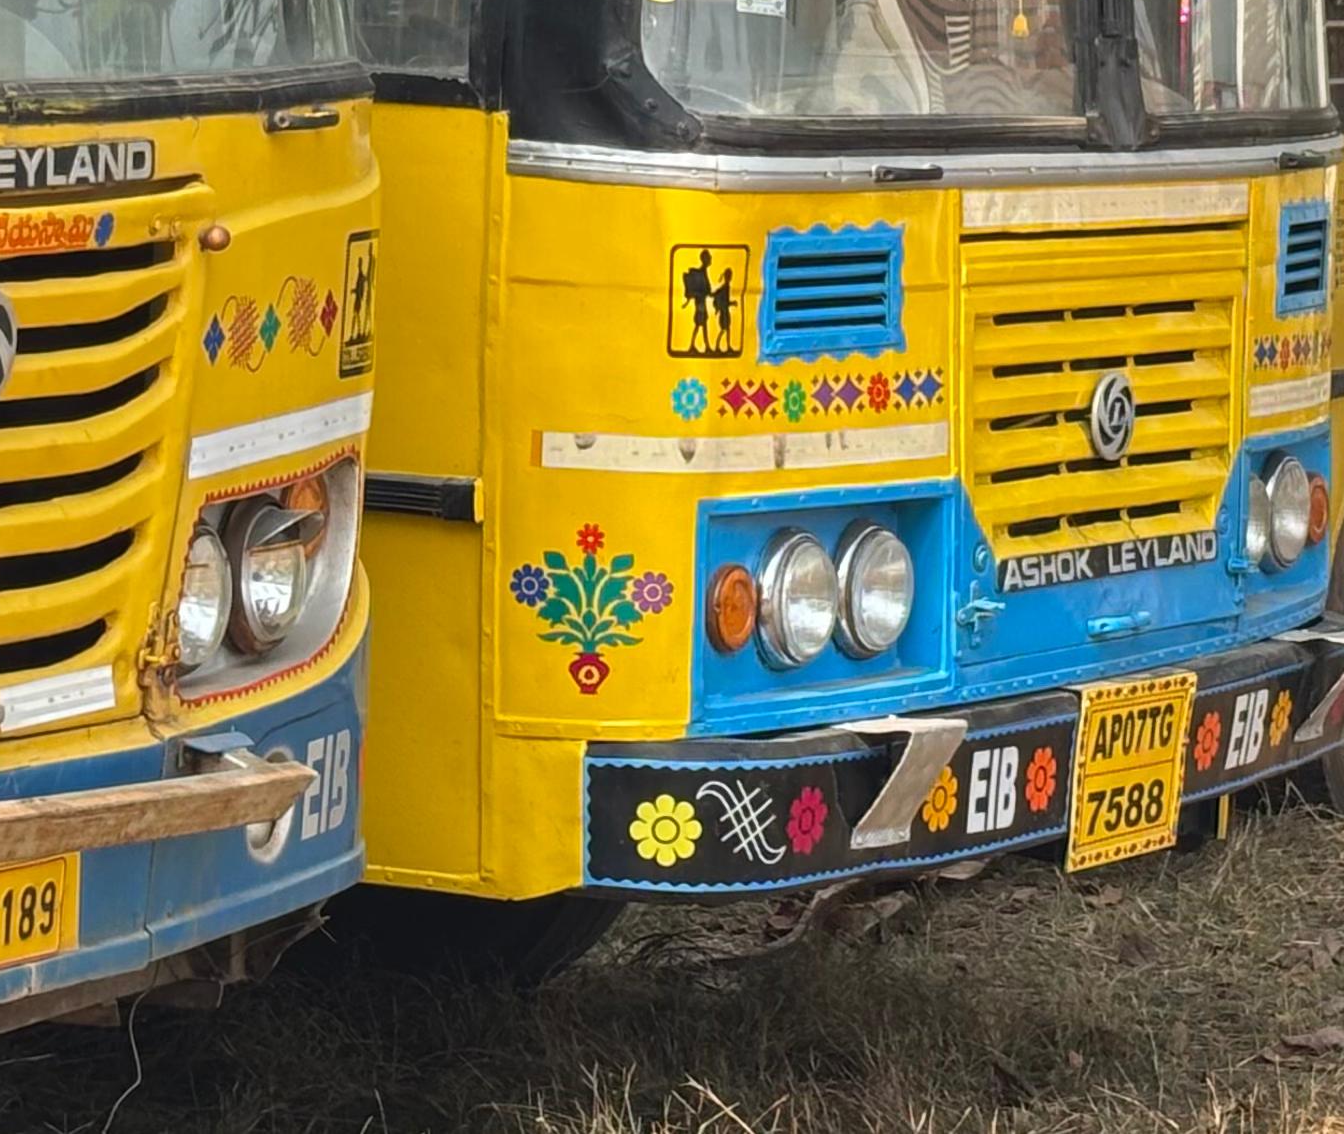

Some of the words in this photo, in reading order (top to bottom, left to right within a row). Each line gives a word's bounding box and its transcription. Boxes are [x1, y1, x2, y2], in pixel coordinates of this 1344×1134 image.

[1002, 548, 1094, 591] ASHOK
[1107, 529, 1217, 574] LEYLAND
[1091, 702, 1175, 763] AP07TG
[1224, 688, 1269, 770] EIB
[301, 728, 351, 841] EIB
[966, 746, 1019, 834] EIB
[1086, 778, 1165, 836] 7588
